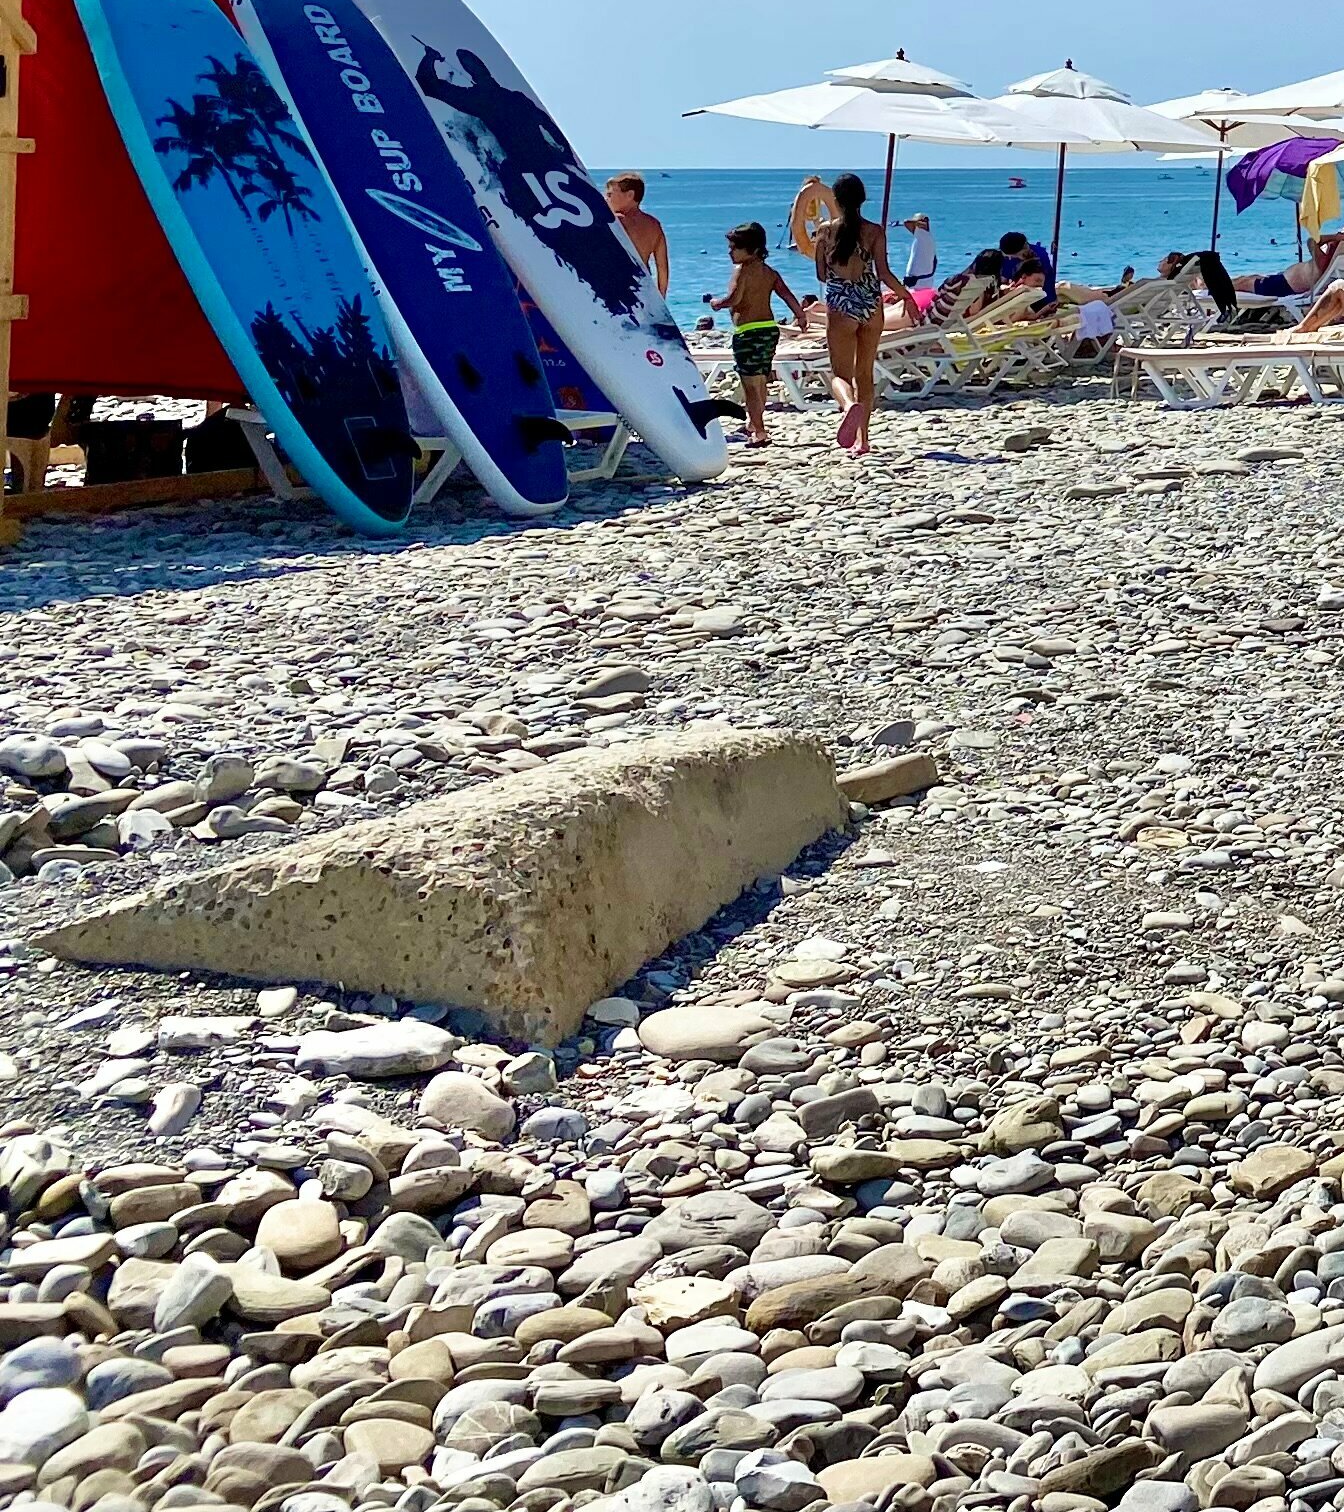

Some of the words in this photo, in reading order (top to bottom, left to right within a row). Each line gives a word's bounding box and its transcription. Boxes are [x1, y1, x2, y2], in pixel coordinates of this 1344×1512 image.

[303, 3, 385, 113] BOARD
[371, 128, 423, 192] SUP
[424, 243, 473, 292] MY
